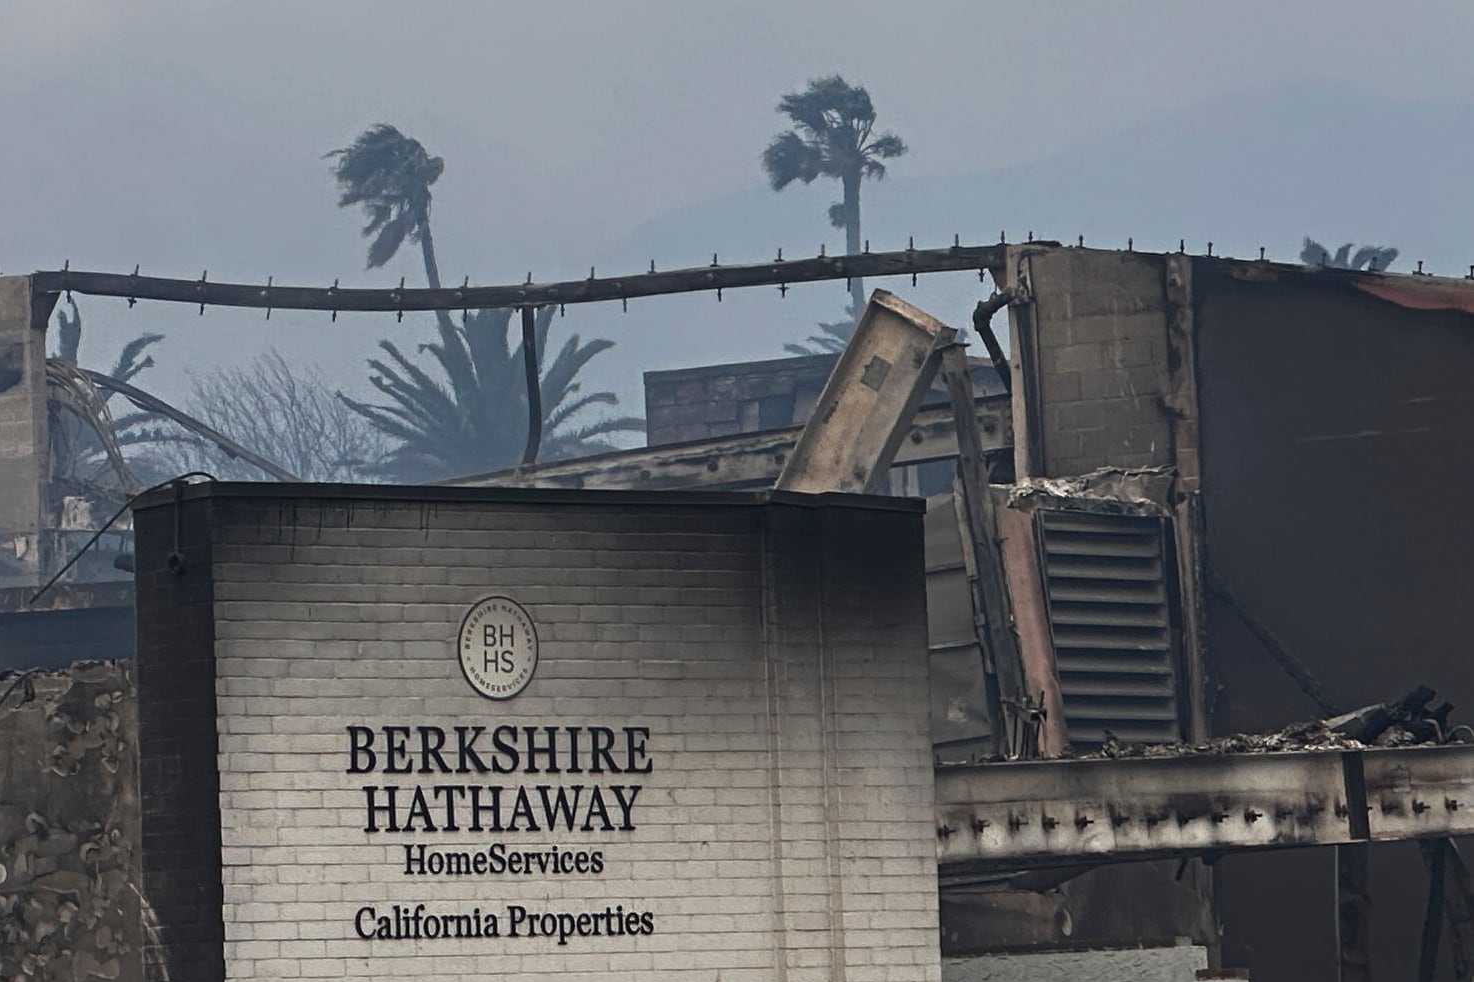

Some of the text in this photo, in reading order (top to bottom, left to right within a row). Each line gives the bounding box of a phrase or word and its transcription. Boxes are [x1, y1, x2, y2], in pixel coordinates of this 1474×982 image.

[483, 624, 514, 647] BH
[484, 650, 515, 673] HS
[346, 726, 652, 774] BERKSHIRE
[363, 785, 642, 833] HATHAWAY
[403, 844, 603, 875] HomeServices
[355, 904, 653, 945] California Properties
